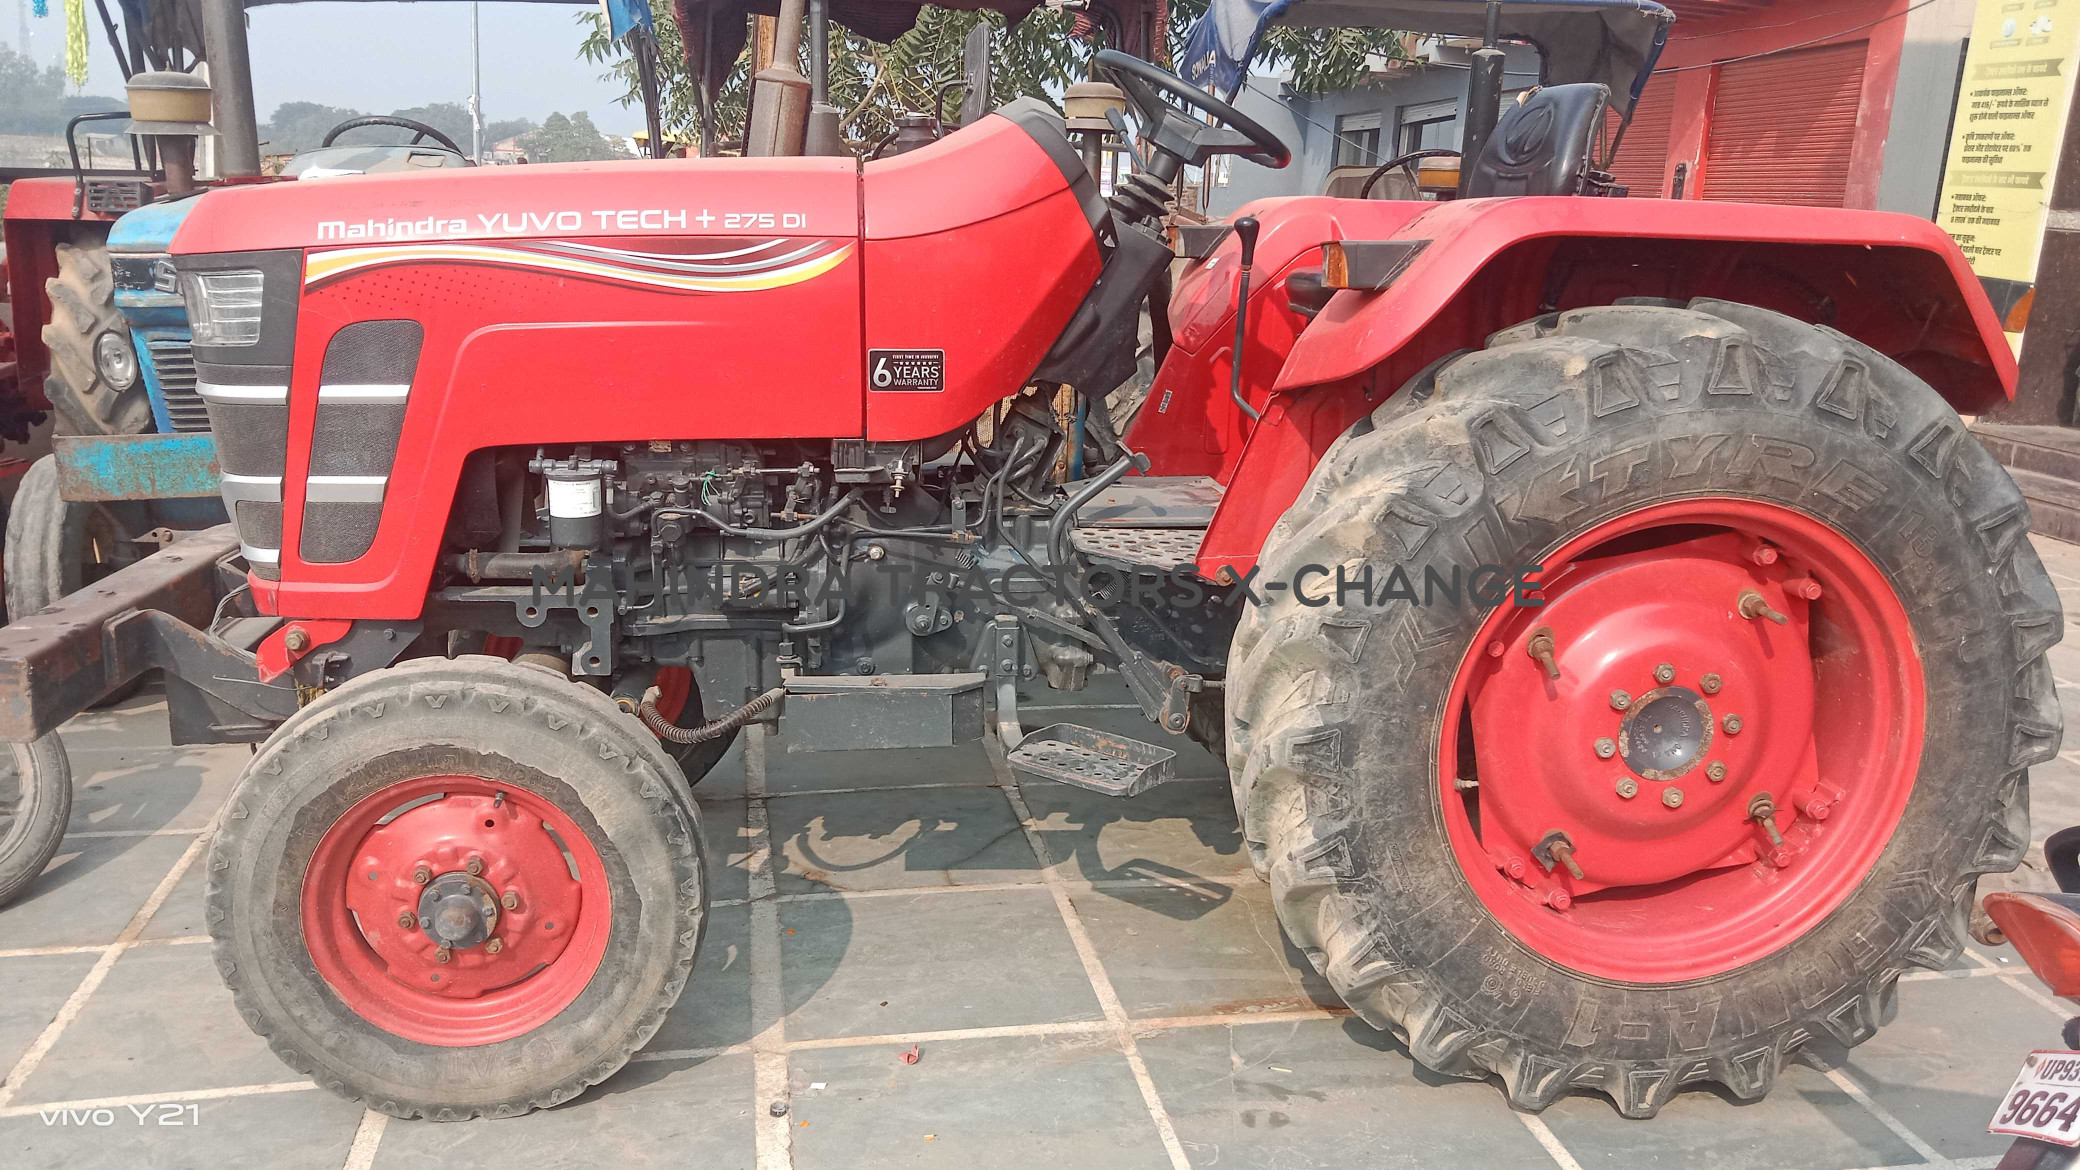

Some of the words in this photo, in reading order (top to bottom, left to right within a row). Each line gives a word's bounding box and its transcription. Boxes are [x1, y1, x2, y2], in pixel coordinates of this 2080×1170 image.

[317, 217, 468, 239] Mahindra
[477, 210, 582, 234] YUVO
[592, 209, 687, 230] TECH
[695, 210, 717, 228] +
[723, 213, 777, 230] 275
[782, 212, 807, 229] DI
[873, 358, 892, 388] 6
[1588, 432, 1890, 513] TYRE
[1998, 1090, 2080, 1132] 9664
